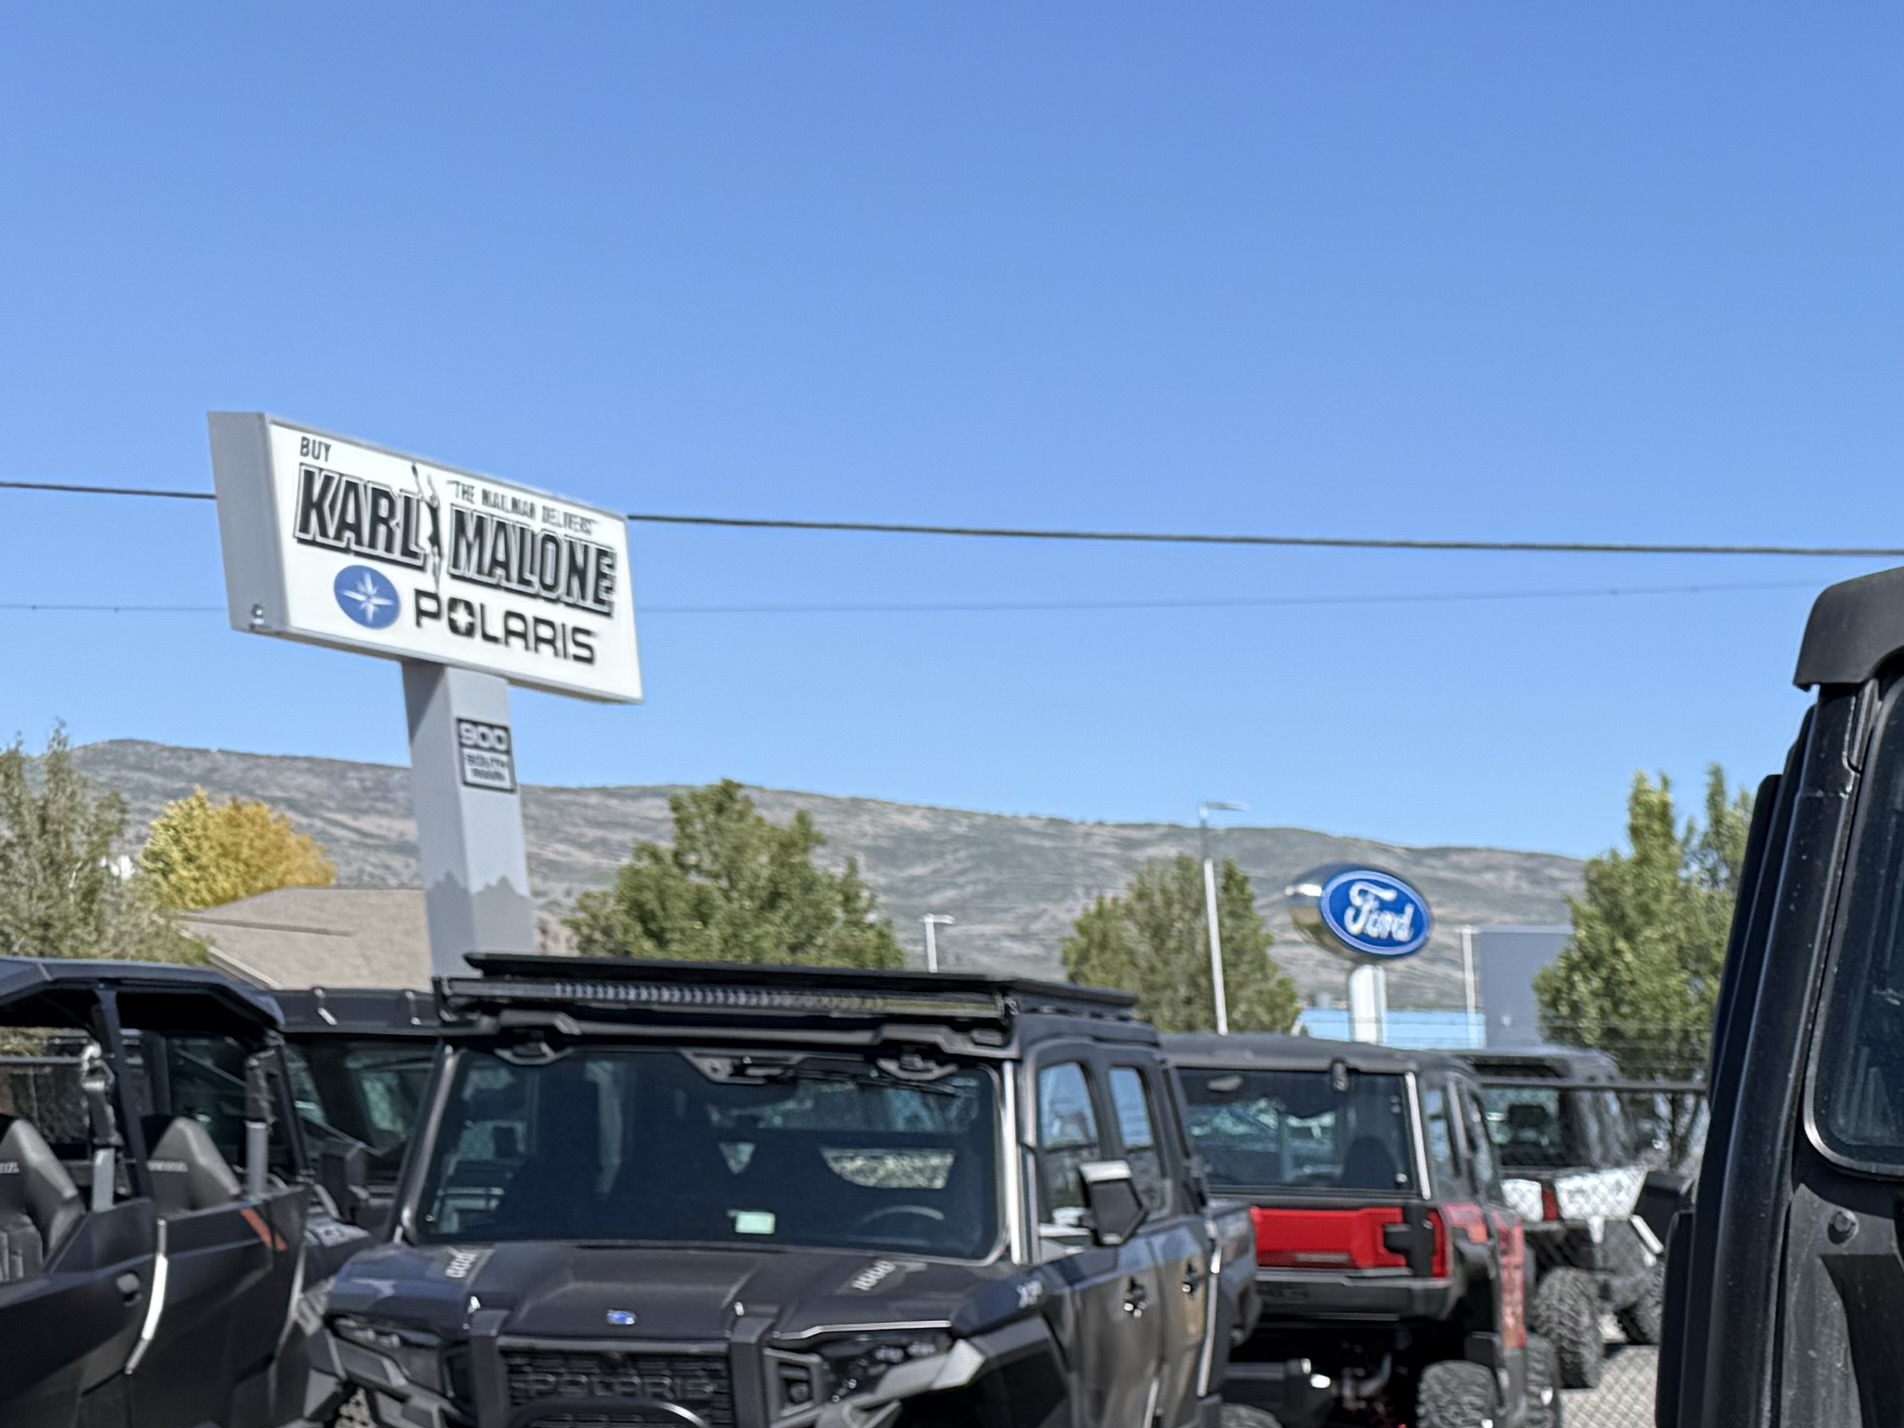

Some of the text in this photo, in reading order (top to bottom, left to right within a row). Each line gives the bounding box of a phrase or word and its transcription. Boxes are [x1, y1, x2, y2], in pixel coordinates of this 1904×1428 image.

[300, 435, 332, 463] BUY
[294, 463, 617, 620] KARL MALONE
[414, 588, 598, 666] POLARIS
[460, 722, 508, 752] 900
[1344, 881, 1415, 942] Ford
